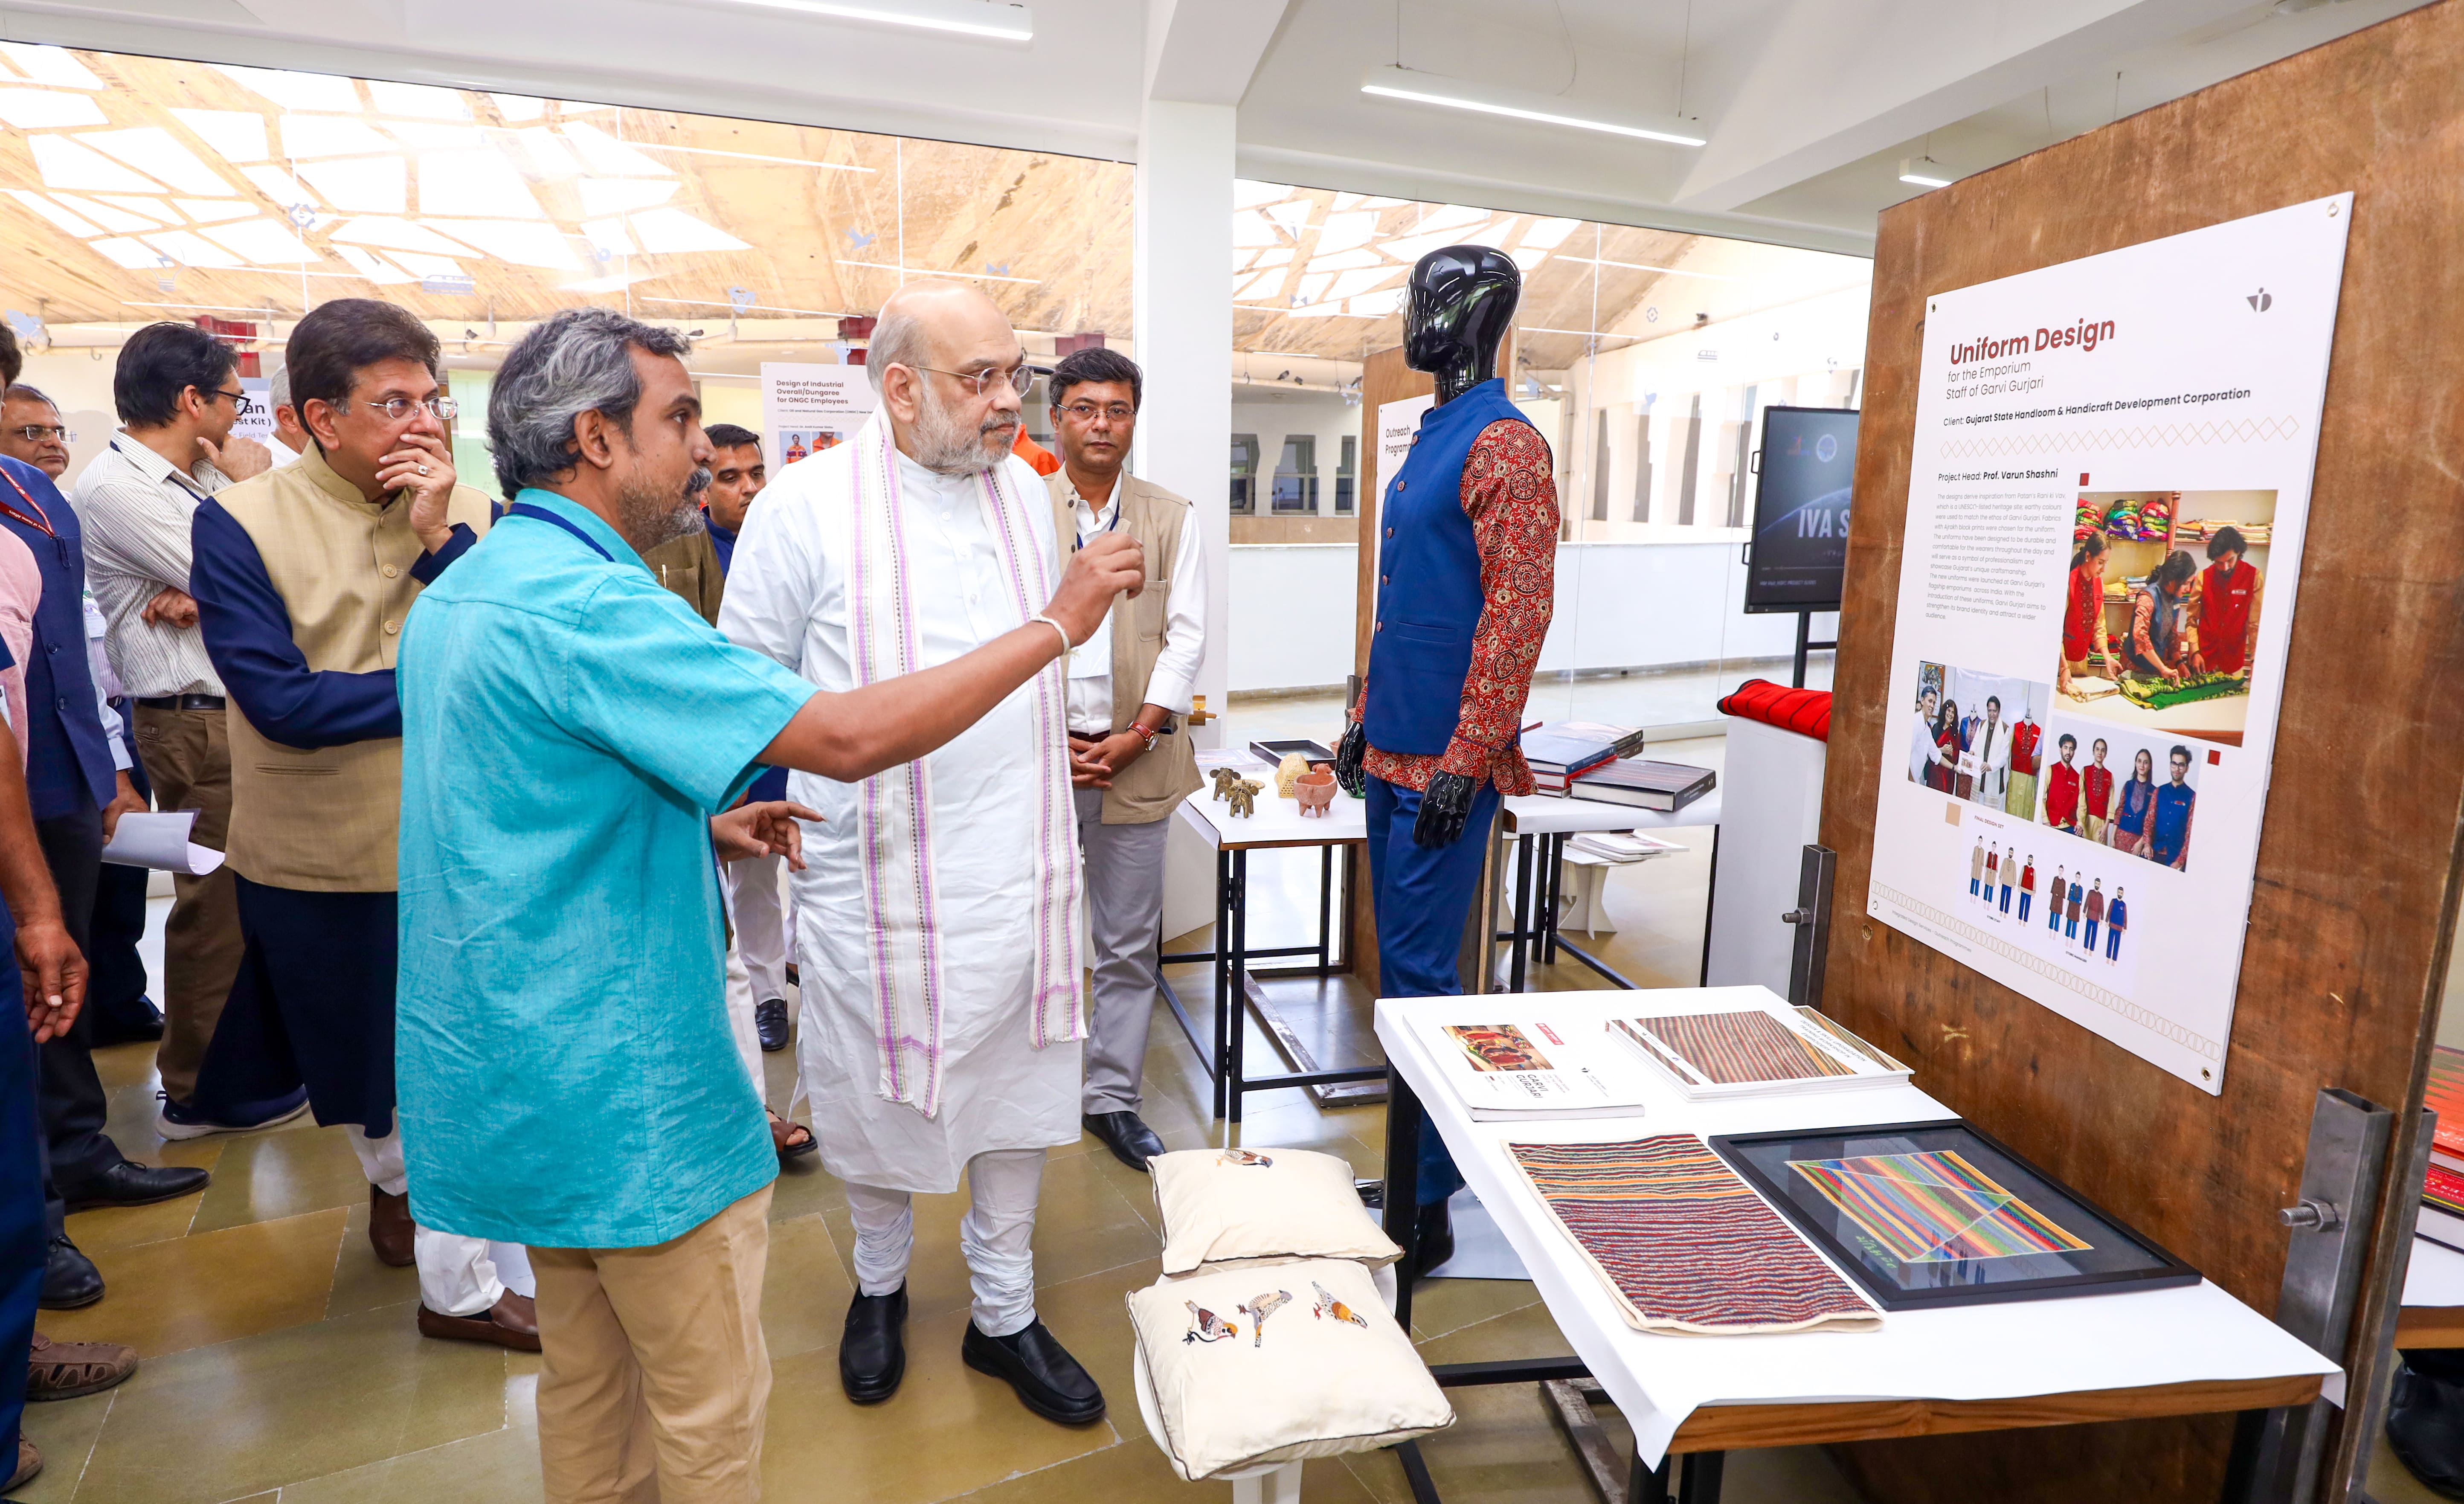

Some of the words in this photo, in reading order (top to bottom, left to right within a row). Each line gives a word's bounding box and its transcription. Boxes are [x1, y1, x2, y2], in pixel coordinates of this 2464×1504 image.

[1950, 336, 2029, 365] Uniform
[2034, 318, 2114, 351] Design
[1948, 371, 1960, 382] for
[1962, 369, 1977, 380] the
[1979, 361, 2030, 378] Emporium
[777, 388, 839, 397] Overall/Dungaree
[1946, 386, 1967, 399] Staff
[1969, 384, 1979, 396] of
[1981, 380, 2006, 395] Garvi
[2009, 375, 2043, 393] Gurjari
[1944, 417, 1964, 426] Client:
[1966, 414, 1992, 426] Gujarat
[1994, 412, 2013, 421] State
[2014, 409, 2055, 419] Handloom
[2057, 406, 2063, 415] &
[2066, 401, 2112, 414] Handicraft
[2115, 395, 2180, 410] Development
[2183, 388, 2250, 405] Corporation
[1386, 424, 1410, 438] Outreach
[1938, 473, 1960, 483] Project
[1962, 472, 1981, 480] Head:
[1983, 470, 1999, 479] Prof.
[2026, 468, 2058, 478] Shashni
[9, 510, 21, 519] Affairs
[22, 516, 33, 525] Home
[1798, 508, 1832, 538] IVA
[1927, 592, 1953, 600] introduction
[2009, 601, 2026, 609] Gurjari
[1971, 607, 1988, 615] identity
[1516, 1074, 1543, 1098] GURJARI
[1528, 1074, 1549, 1092] GARVI
